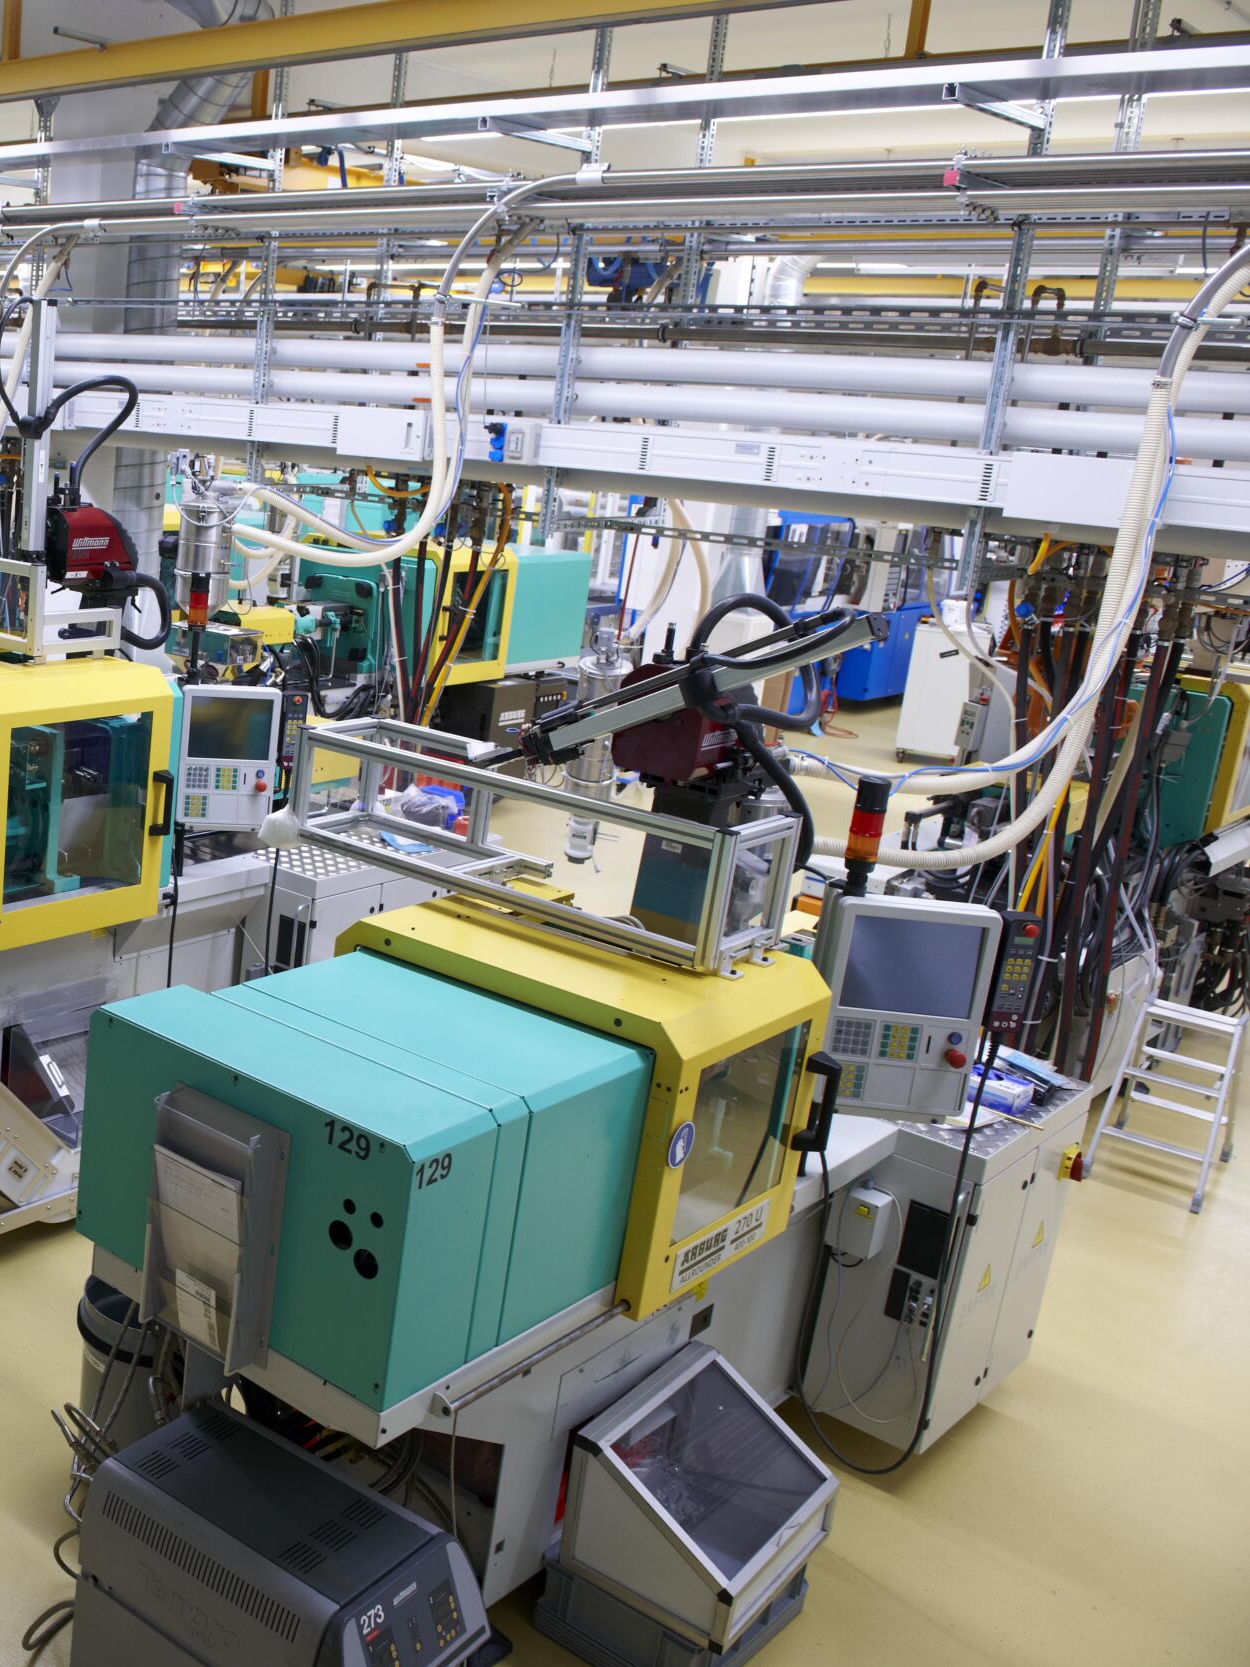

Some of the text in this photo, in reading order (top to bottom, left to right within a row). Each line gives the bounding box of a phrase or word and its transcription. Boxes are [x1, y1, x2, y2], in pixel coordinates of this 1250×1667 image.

[324, 1119, 371, 1161] 129
[416, 1152, 453, 1190] 129
[681, 1206, 763, 1267] ARBURG 270 U
[679, 1252, 722, 1285] ALLROUNDER
[360, 1604, 385, 1635] 273
